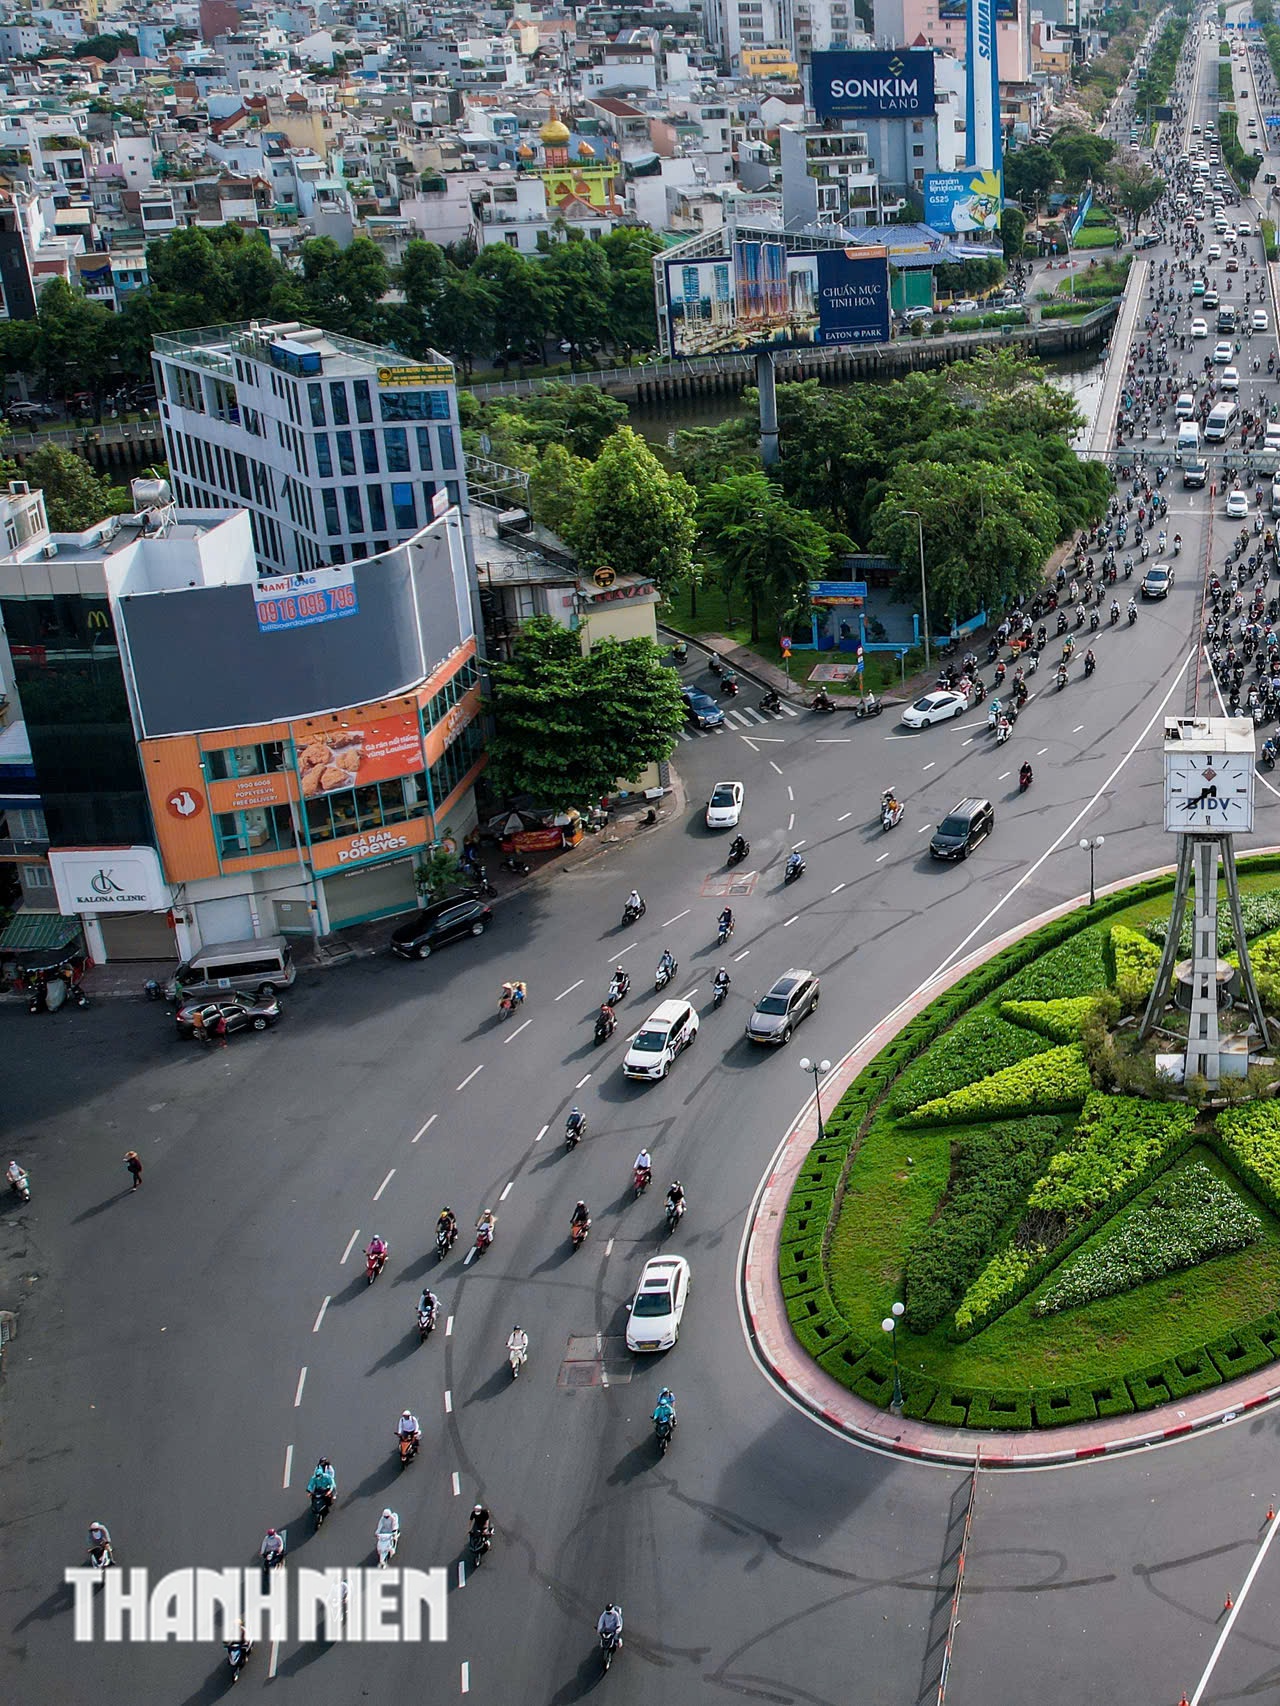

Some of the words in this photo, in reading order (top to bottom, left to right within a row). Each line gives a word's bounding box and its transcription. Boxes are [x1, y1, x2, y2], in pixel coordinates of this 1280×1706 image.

[978, 0, 990, 61] SAWA
[831, 79, 918, 98] SONKIM
[880, 99, 919, 110] LAND
[929, 195, 950, 204] GS25
[829, 298, 852, 308] TINH
[855, 297, 876, 306] HOA
[825, 331, 852, 340] EATON
[861, 329, 882, 337] PARK
[260, 583, 285, 592] NAM
[258, 598, 297, 624] 0916
[298, 592, 327, 617] 095
[328, 586, 356, 611] 795
[261, 608, 357, 631] billboardquangcao.com
[249, 795, 278, 805] DELIVERY
[1187, 798, 1230, 810] BIDV
[351, 835, 367, 848] GÀ
[368, 830, 392, 844] RÁN
[116, 894, 146, 902] CLINIC
